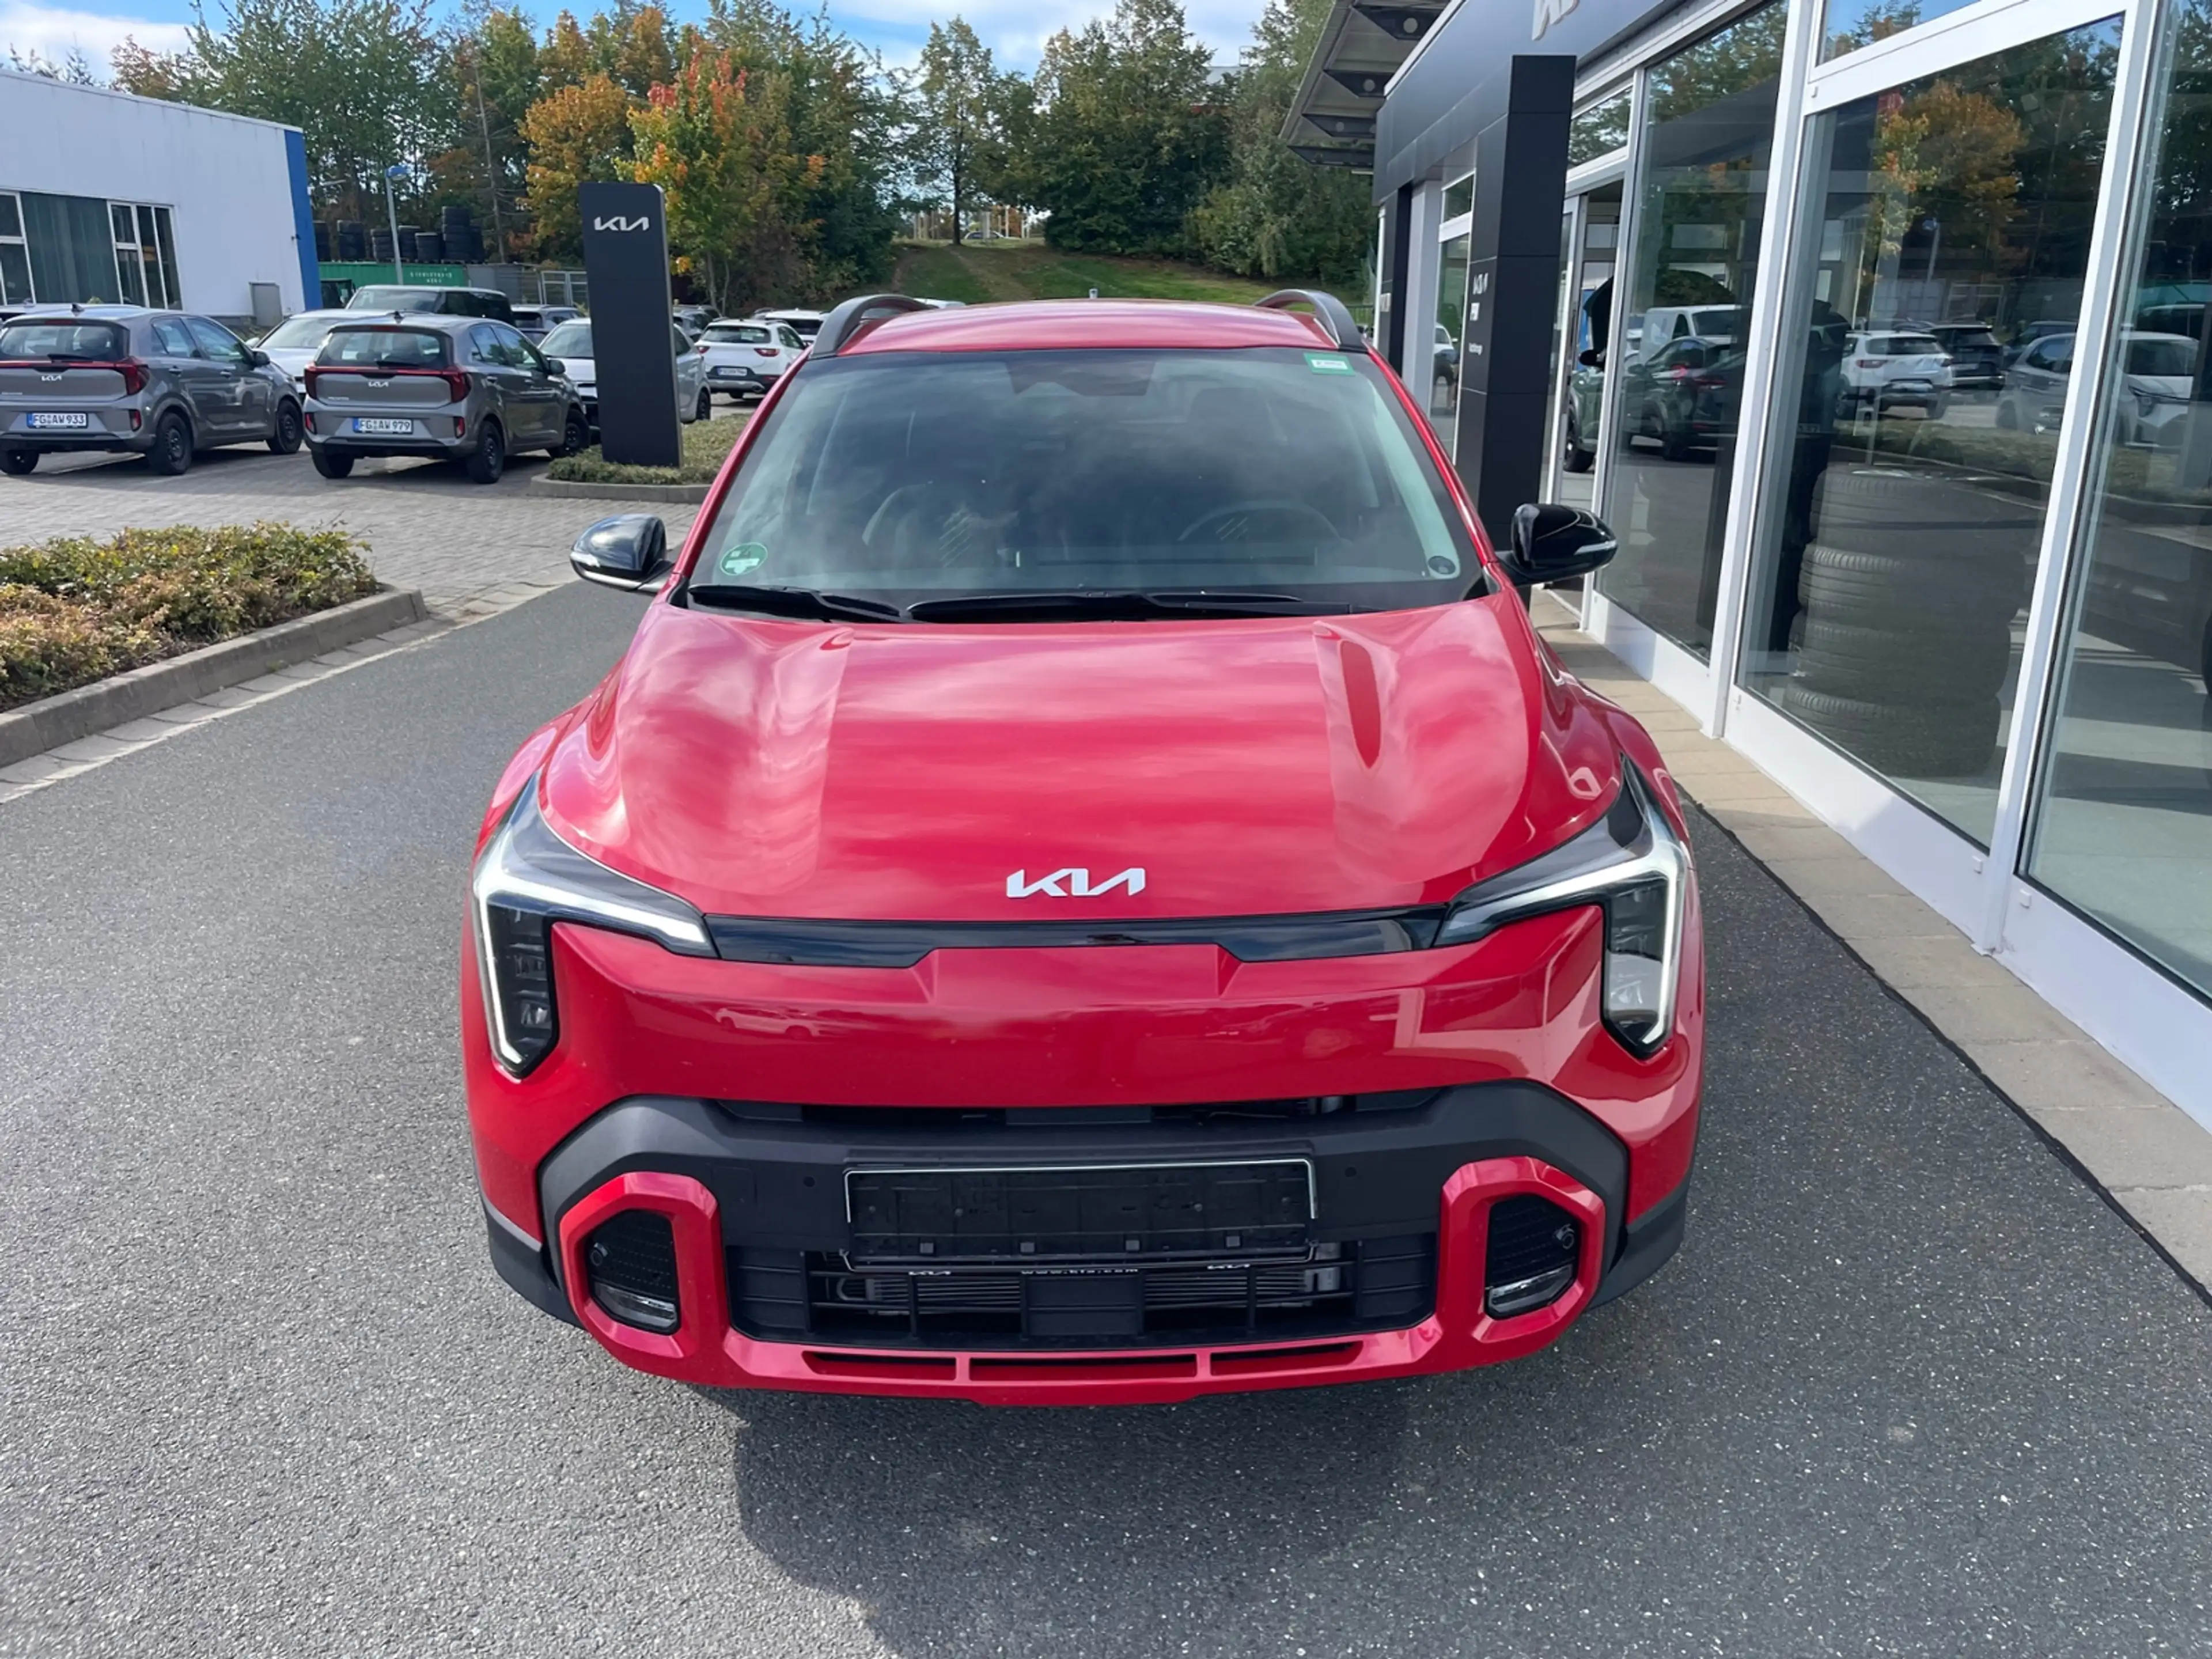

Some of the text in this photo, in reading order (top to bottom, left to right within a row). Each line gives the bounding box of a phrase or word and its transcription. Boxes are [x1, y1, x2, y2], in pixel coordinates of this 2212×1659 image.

[594, 217, 649, 230] KIA
[66, 415, 85, 423] 933
[392, 421, 410, 430] 979
[1006, 868, 1145, 897] KIA
